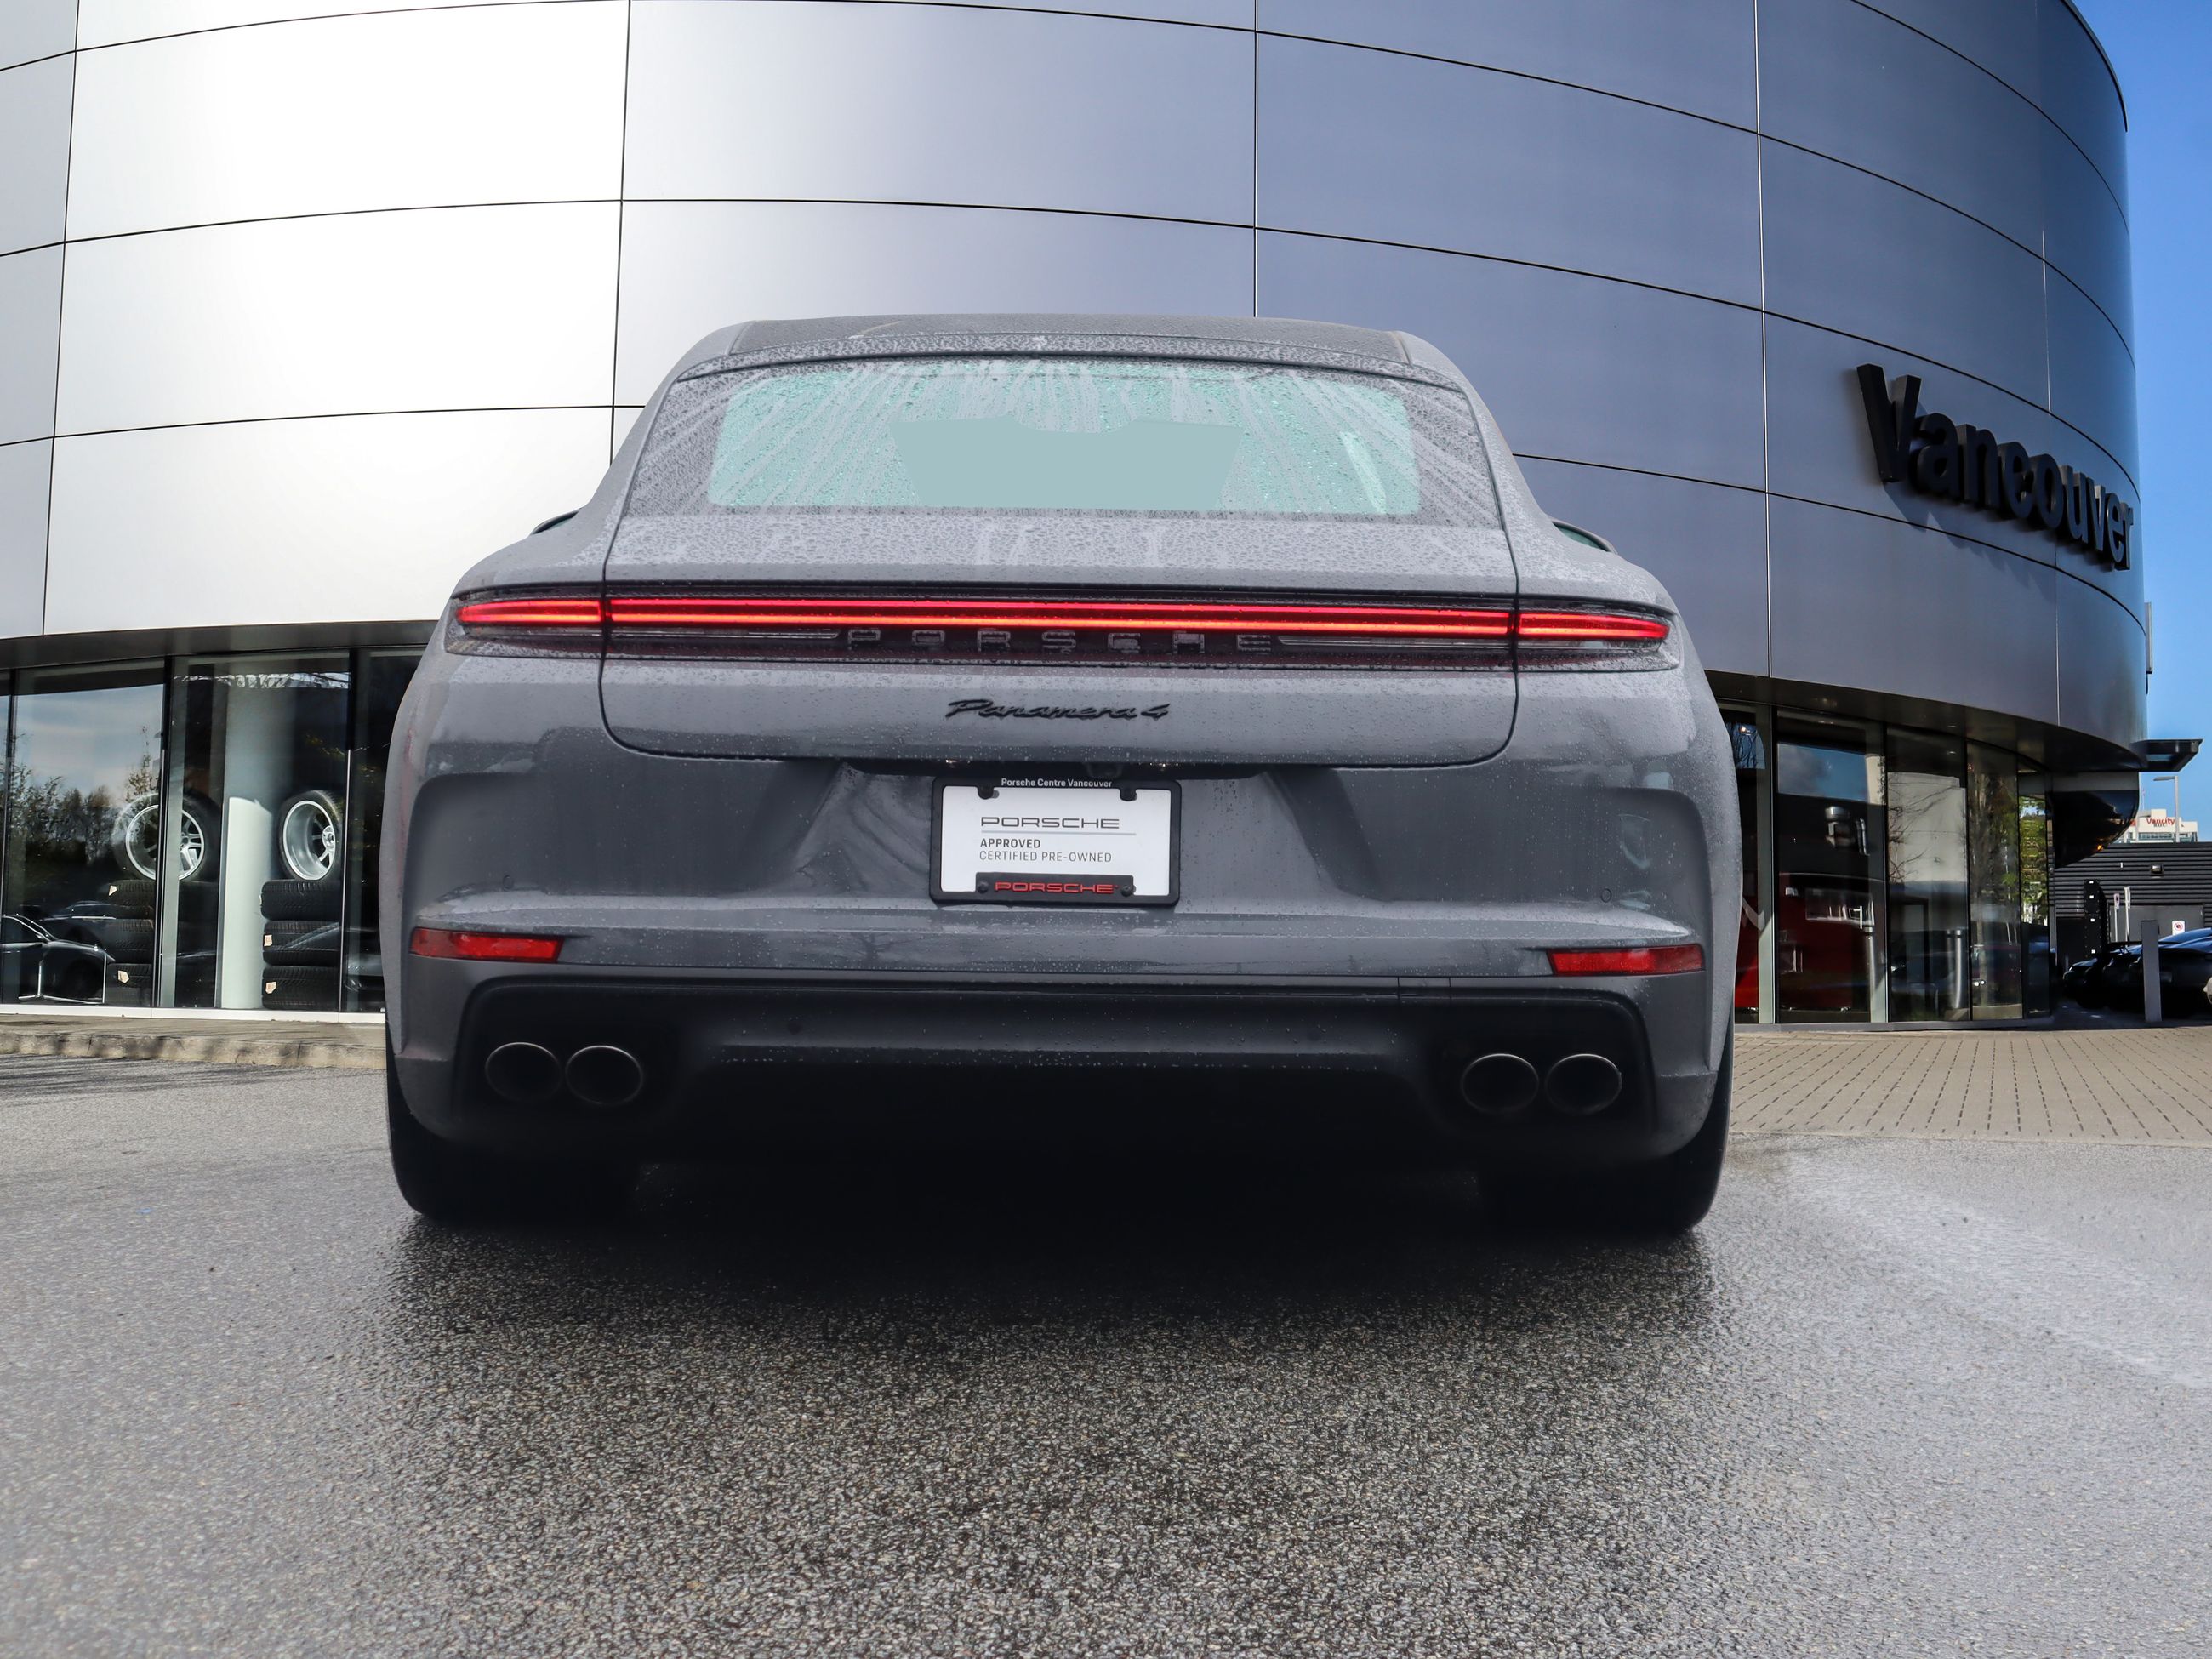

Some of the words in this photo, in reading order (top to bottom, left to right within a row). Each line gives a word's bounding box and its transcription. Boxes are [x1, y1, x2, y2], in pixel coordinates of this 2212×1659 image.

[1856, 362, 2134, 571] Vancouver
[847, 628, 1272, 654] PORSCHE
[945, 698, 1138, 721] Panamera
[1141, 704, 1171, 721] 4
[1001, 778, 1036, 788] Porsche
[1037, 778, 1066, 788] Centre
[1067, 778, 1113, 789] Vancouver
[980, 817, 1120, 830] PORSCHE
[979, 838, 1041, 849] APPROVED
[979, 851, 1038, 862] CERTIFIED
[1040, 852, 1112, 863] PRE-OWNED
[994, 881, 1115, 894] PORSCHE
